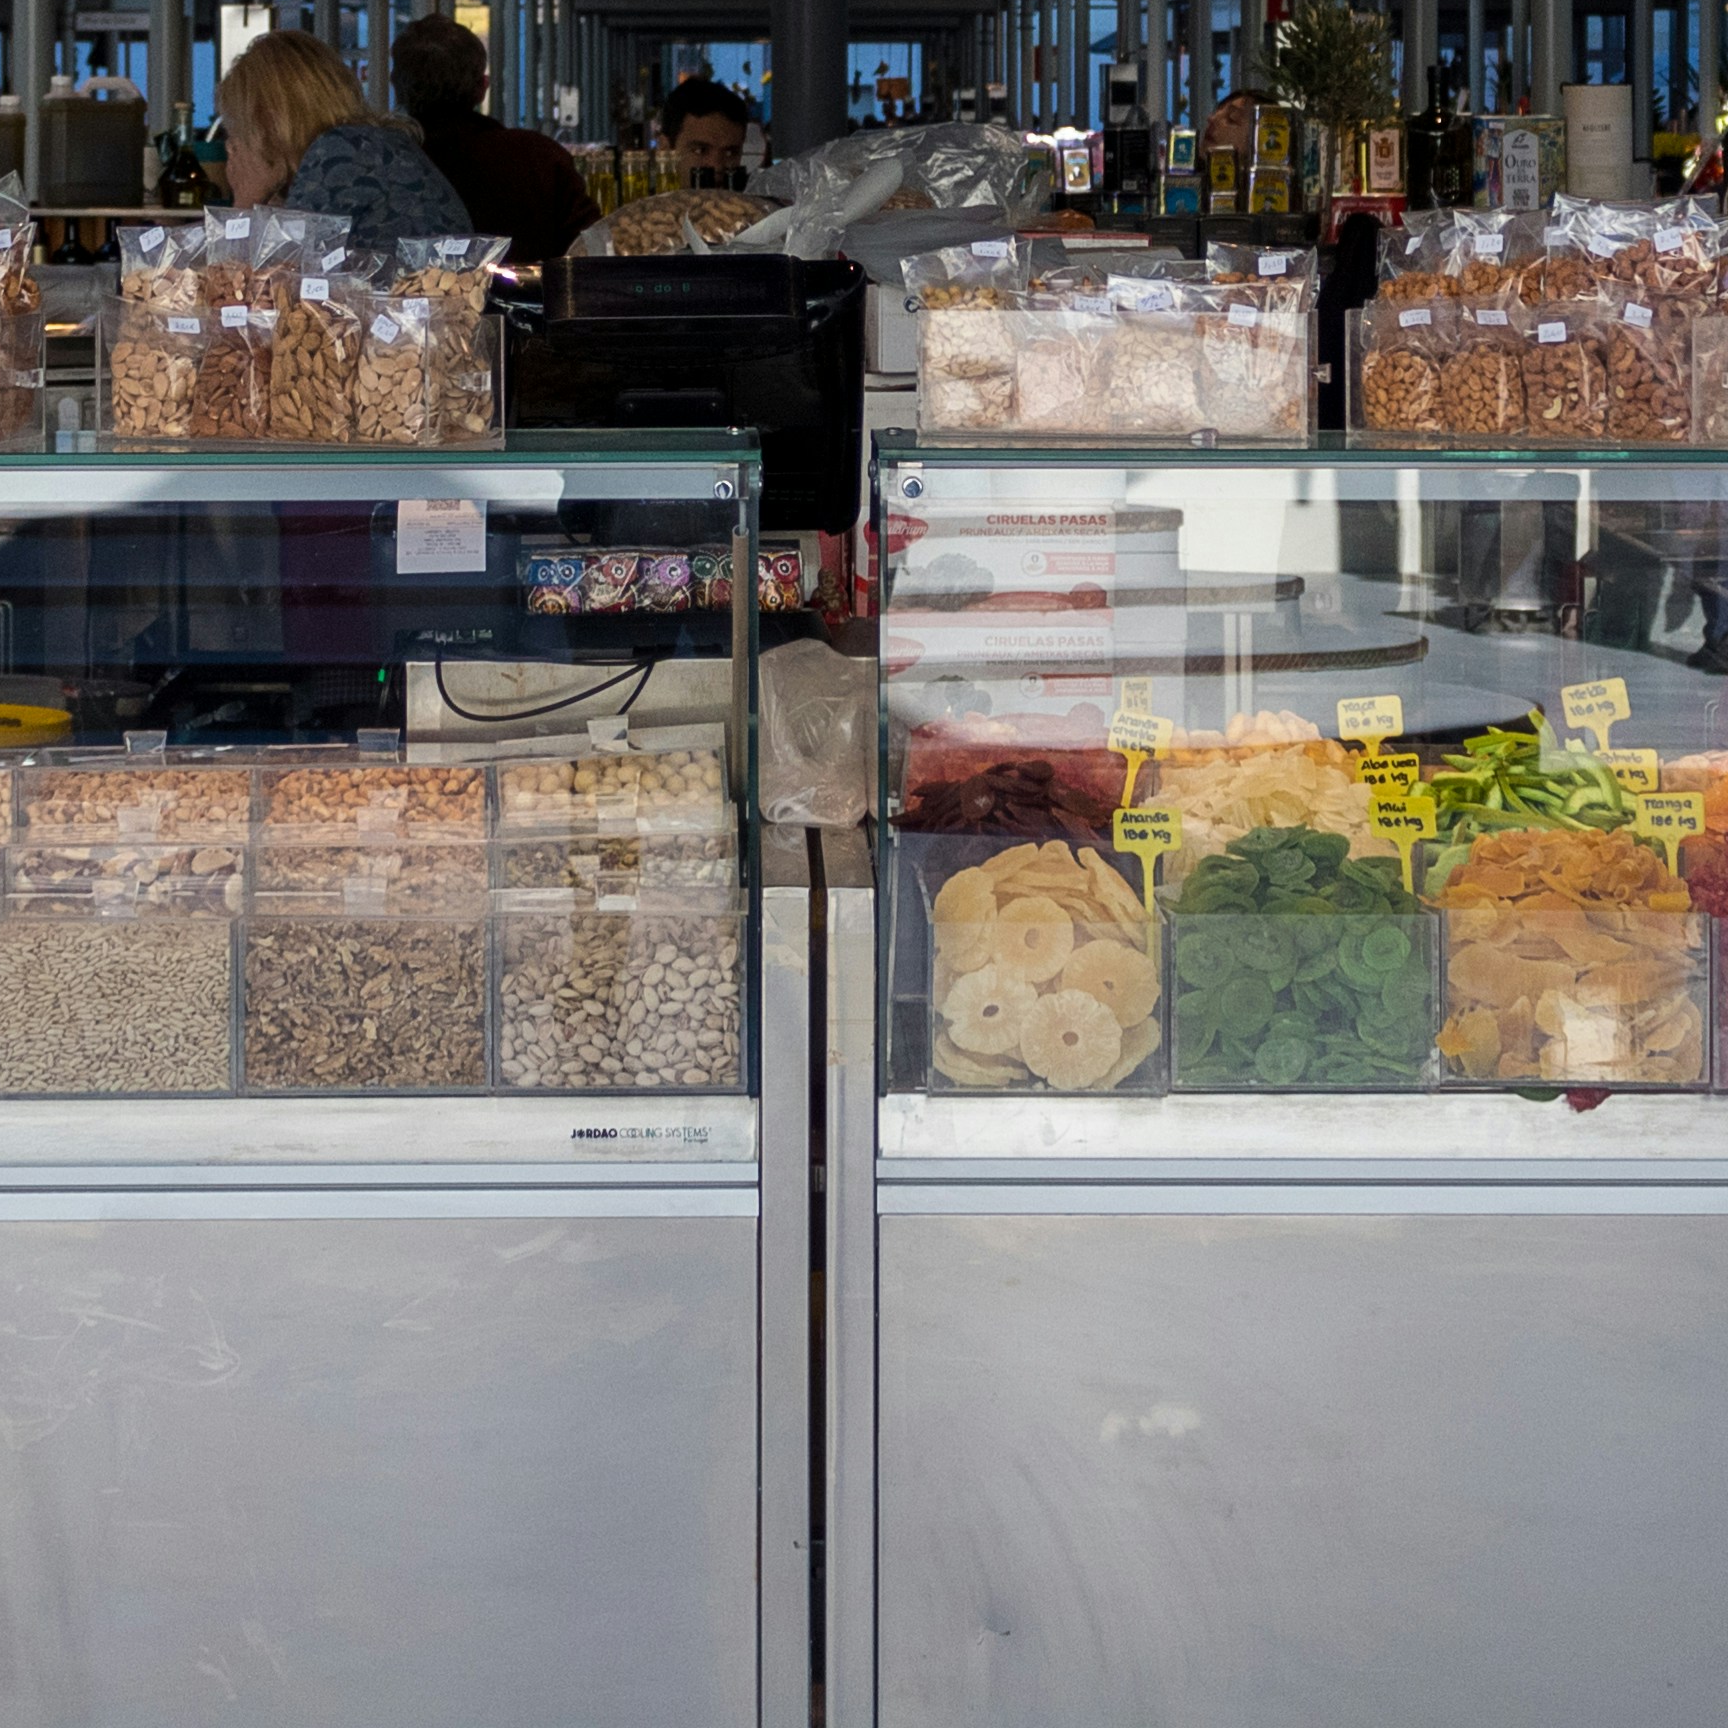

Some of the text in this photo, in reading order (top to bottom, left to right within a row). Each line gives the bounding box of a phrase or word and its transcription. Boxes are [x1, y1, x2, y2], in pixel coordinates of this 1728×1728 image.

[986, 515, 1107, 526] CIRUELAS PASAS
[959, 528, 1016, 537] PRUNEAUX
[984, 635, 1105, 648] CIRUELAS PASAS
[1361, 758, 1389, 771] Aloe
